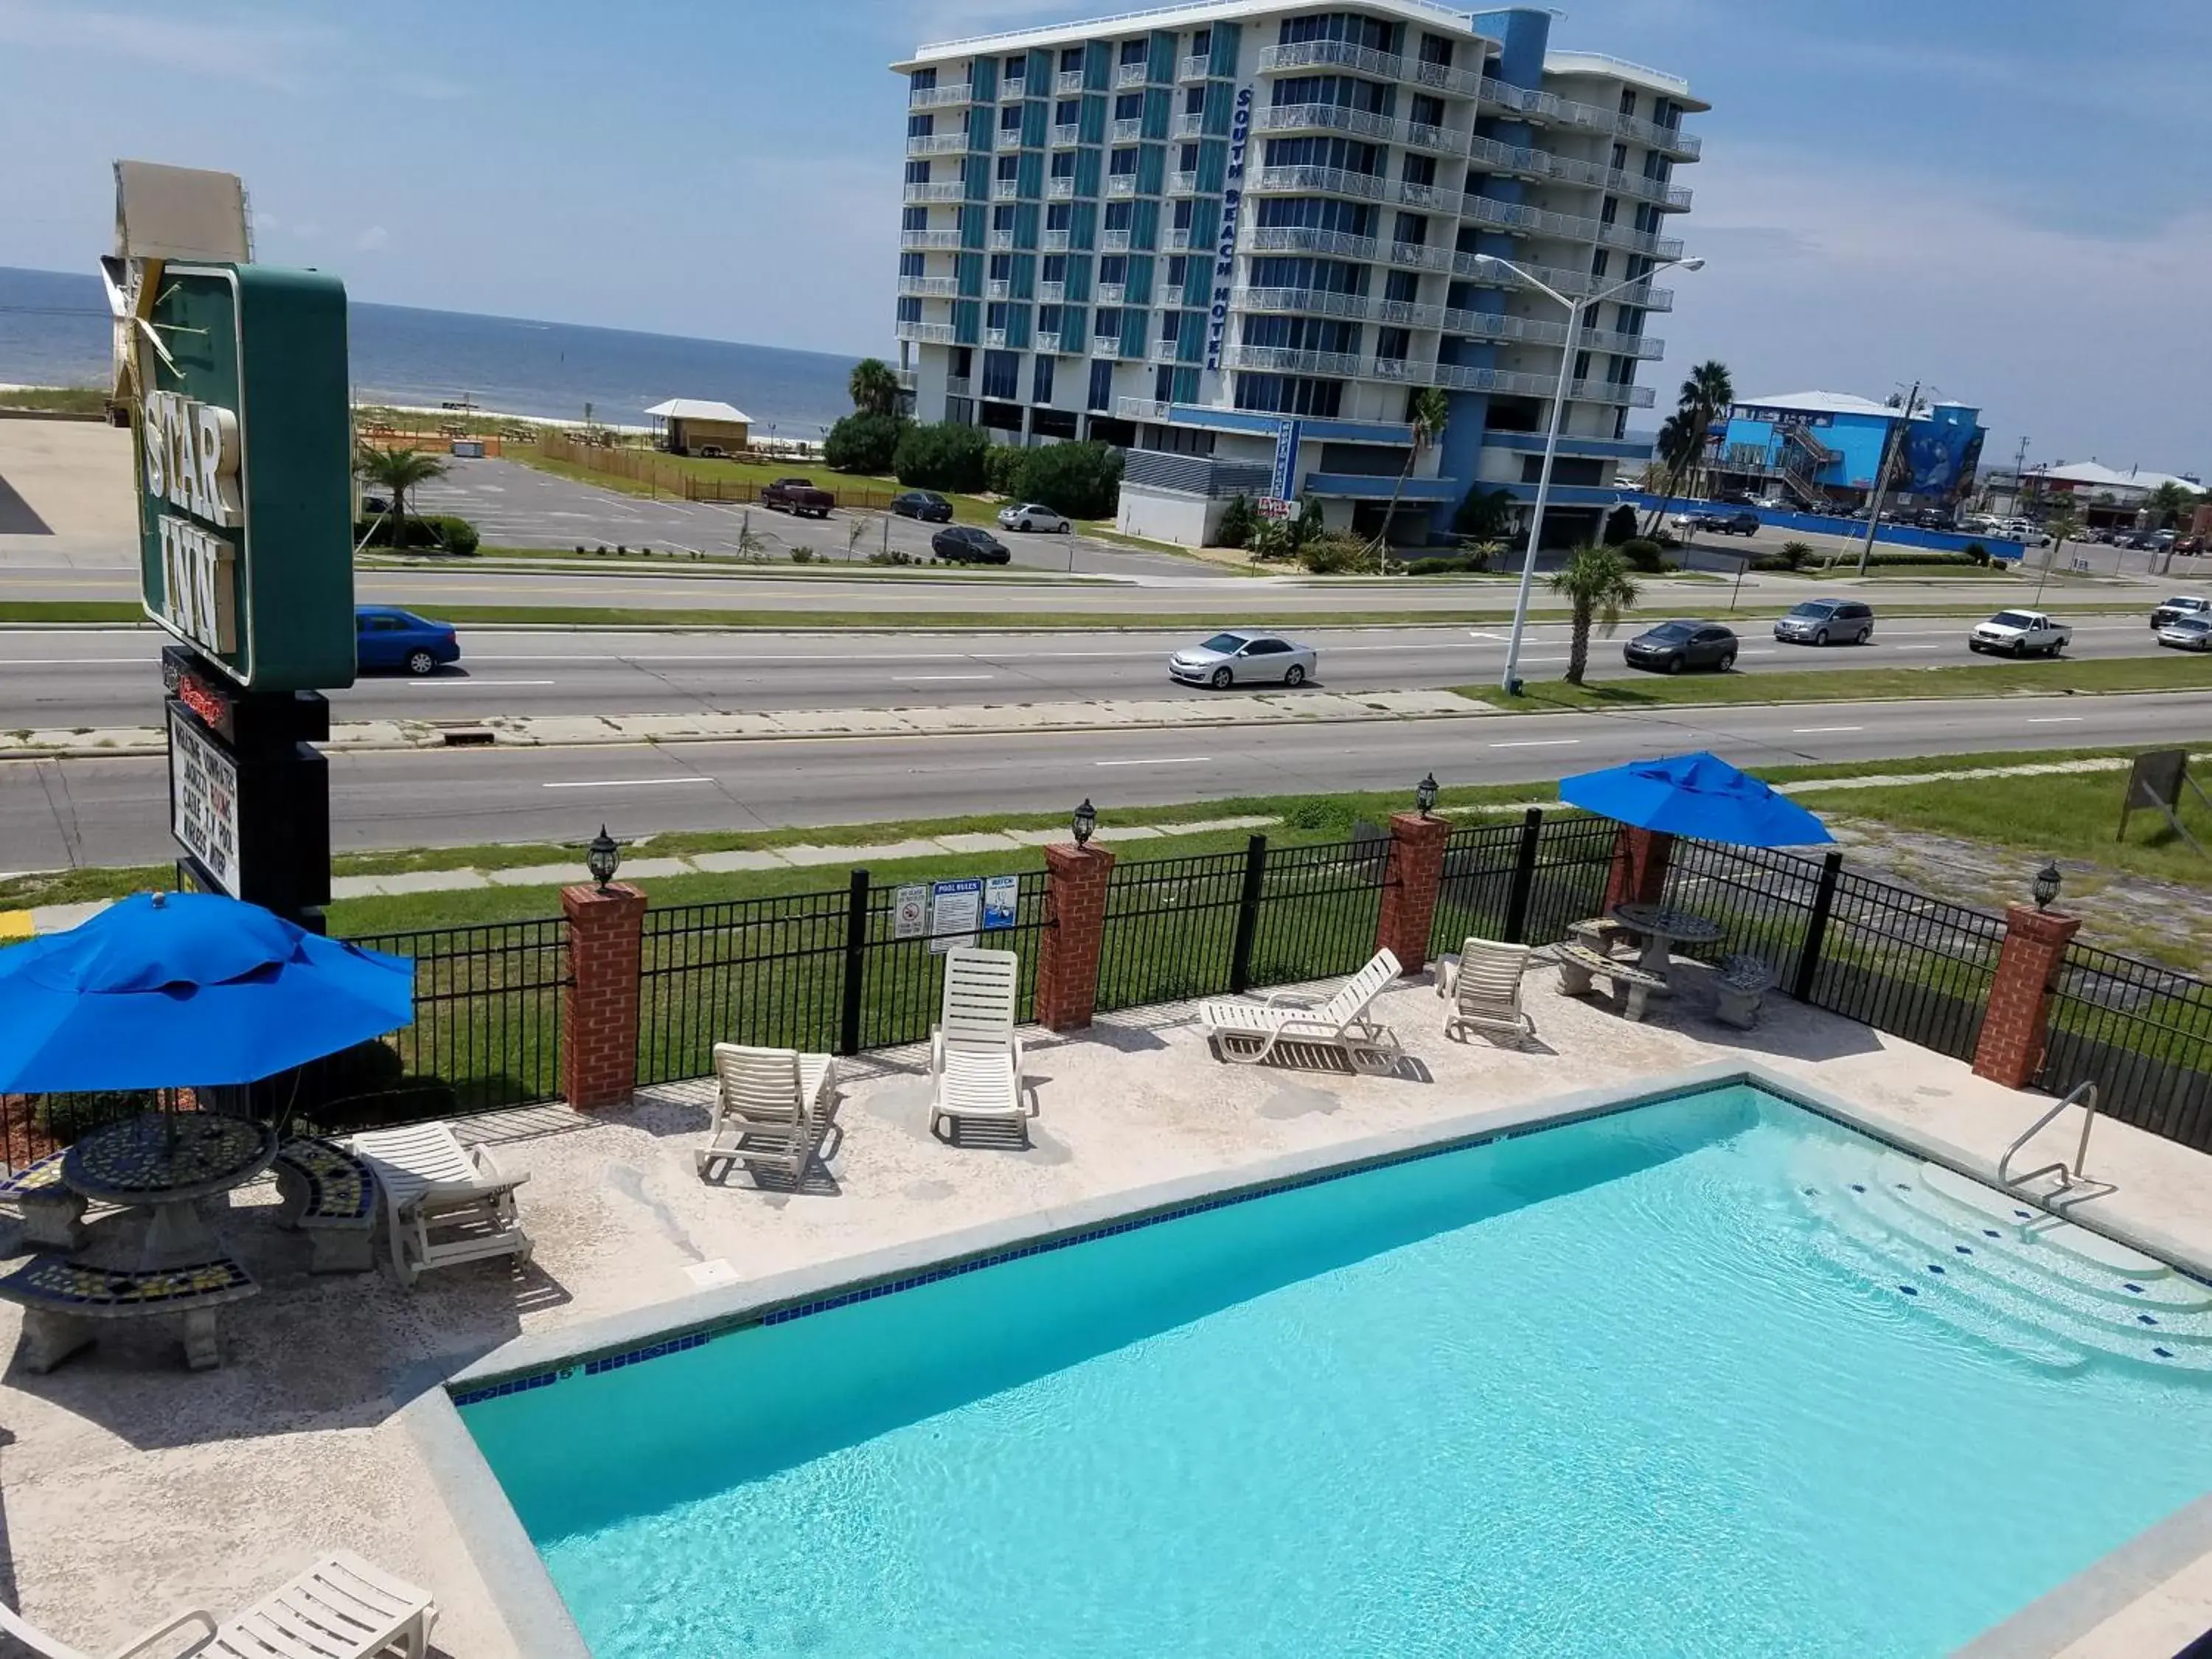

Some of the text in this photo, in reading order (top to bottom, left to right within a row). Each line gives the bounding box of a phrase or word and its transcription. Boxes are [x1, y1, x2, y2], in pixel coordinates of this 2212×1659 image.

[1206, 88, 1251, 371] SOUTH BEACH HOTEL
[146, 389, 243, 527] STAR
[159, 514, 236, 654] INN
[938, 883, 978, 894] POOL RULES
